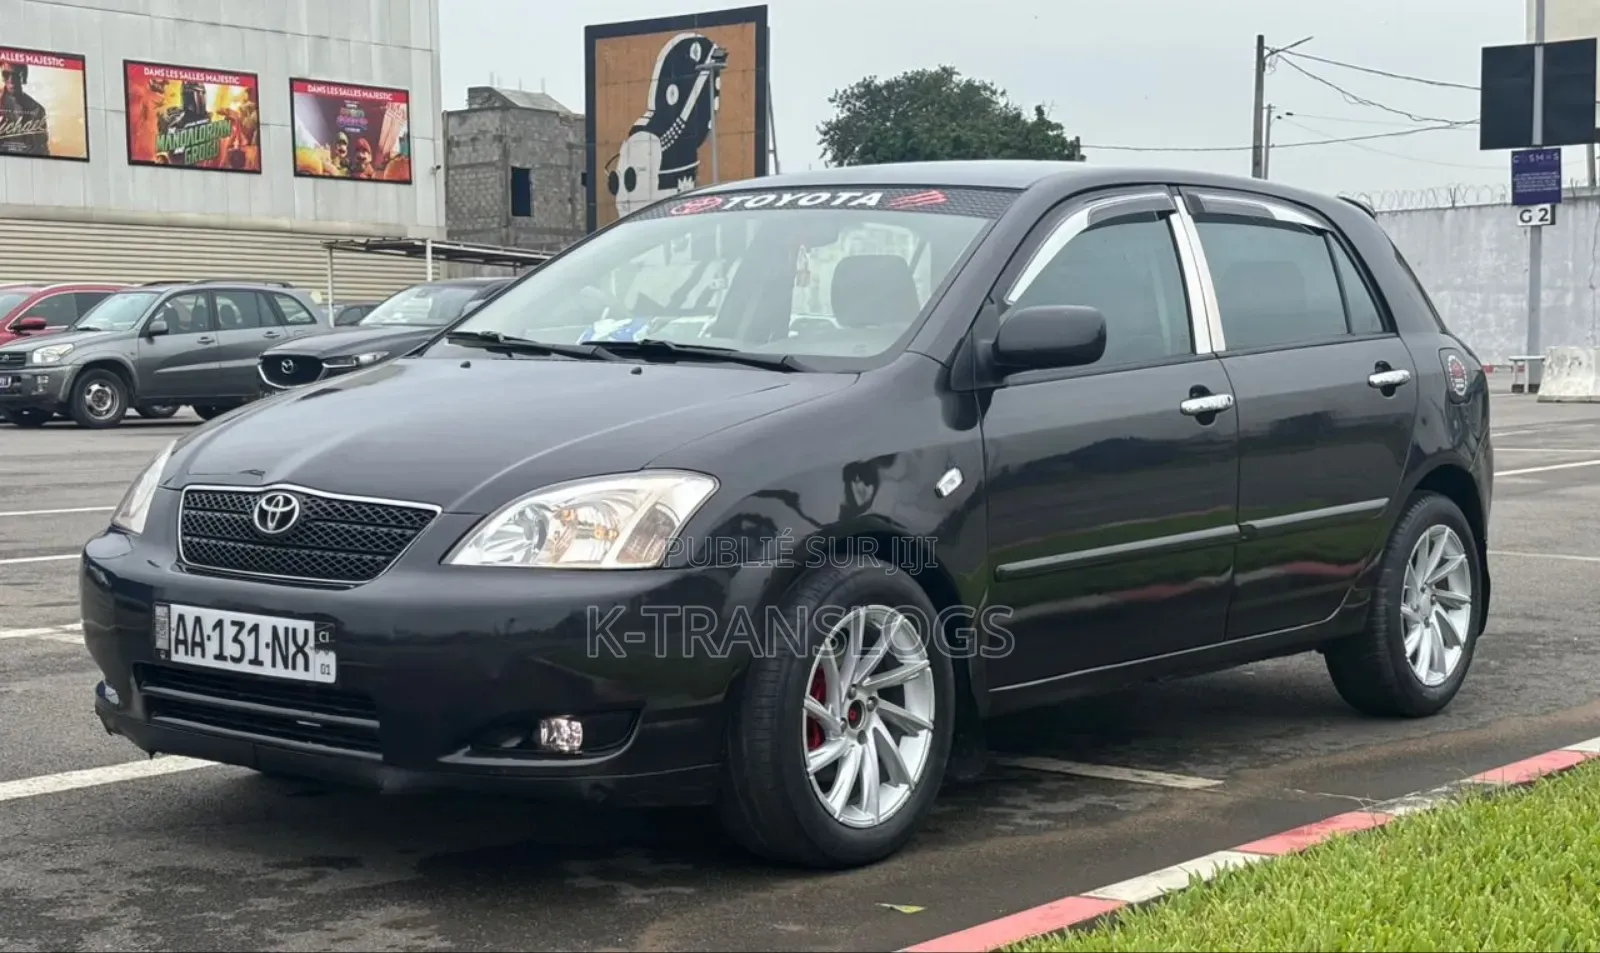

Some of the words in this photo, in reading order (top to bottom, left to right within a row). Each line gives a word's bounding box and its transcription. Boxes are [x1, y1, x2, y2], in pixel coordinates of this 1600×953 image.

[25, 55, 65, 67] MAJESTIC
[143, 67, 165, 77] DANS
[166, 69, 179, 79] LES
[179, 70, 205, 81] SALLES
[205, 73, 240, 85] MAJESTIC
[307, 84, 326, 94] DANS
[327, 86, 339, 95] LES
[339, 87, 361, 97] SALLES
[362, 90, 393, 101] MAJESTIC
[156, 119, 231, 151] MANDALORIAN
[721, 191, 884, 210] TOYOTA
[1519, 208, 1533, 224] G
[1538, 207, 1549, 222] 2
[320, 663, 331, 676] 01
